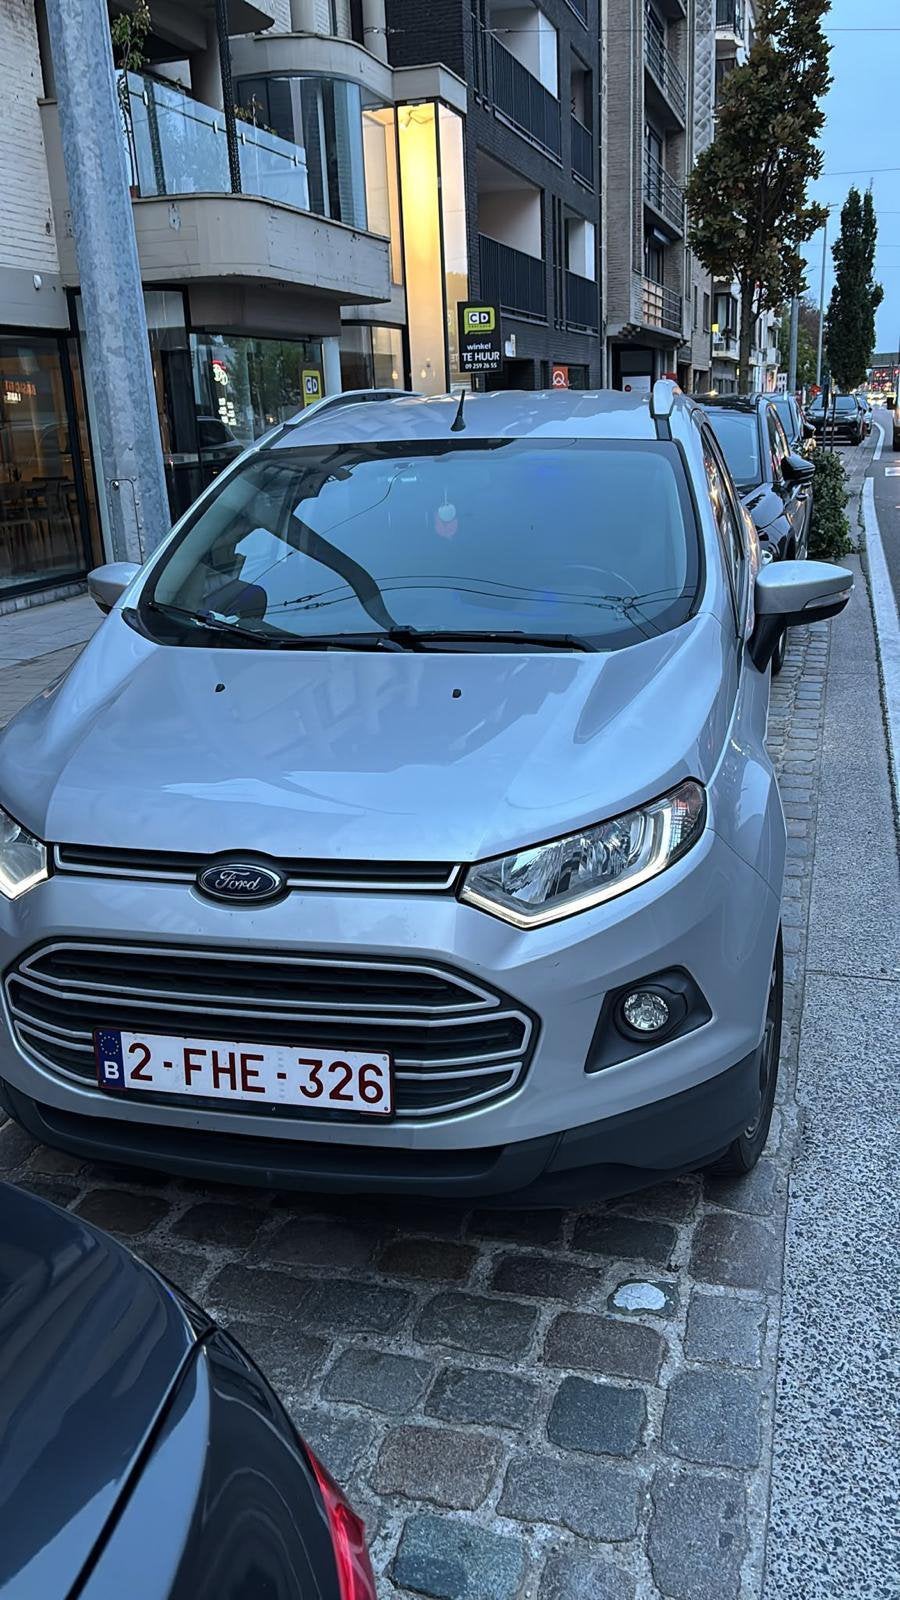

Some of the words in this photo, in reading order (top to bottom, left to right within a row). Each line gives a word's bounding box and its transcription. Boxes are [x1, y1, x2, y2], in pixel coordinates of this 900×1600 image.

[469, 313, 489, 323] CD
[462, 352, 473, 361] TE
[474, 351, 500, 361] HUUR
[306, 376, 318, 394] CD
[215, 870, 261, 890] Ford
[104, 1061, 120, 1079] B
[128, 1042, 384, 1104] 2-FHE-326
